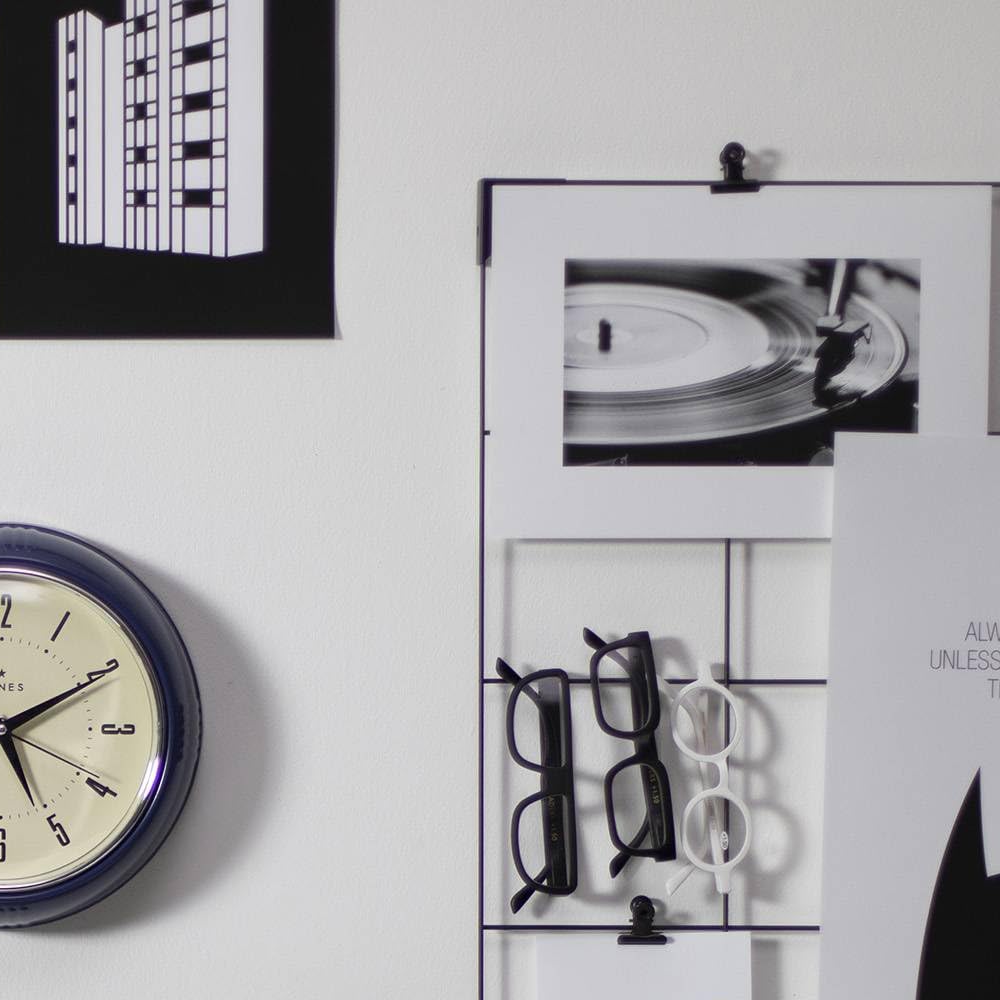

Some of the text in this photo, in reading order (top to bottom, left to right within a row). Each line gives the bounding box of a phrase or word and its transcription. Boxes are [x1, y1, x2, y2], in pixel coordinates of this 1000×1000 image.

[929, 649, 1000, 671] UNLESS
[100, 723, 136, 736] 3
[85, 776, 118, 798] 4
[45, 813, 71, 847] 5
